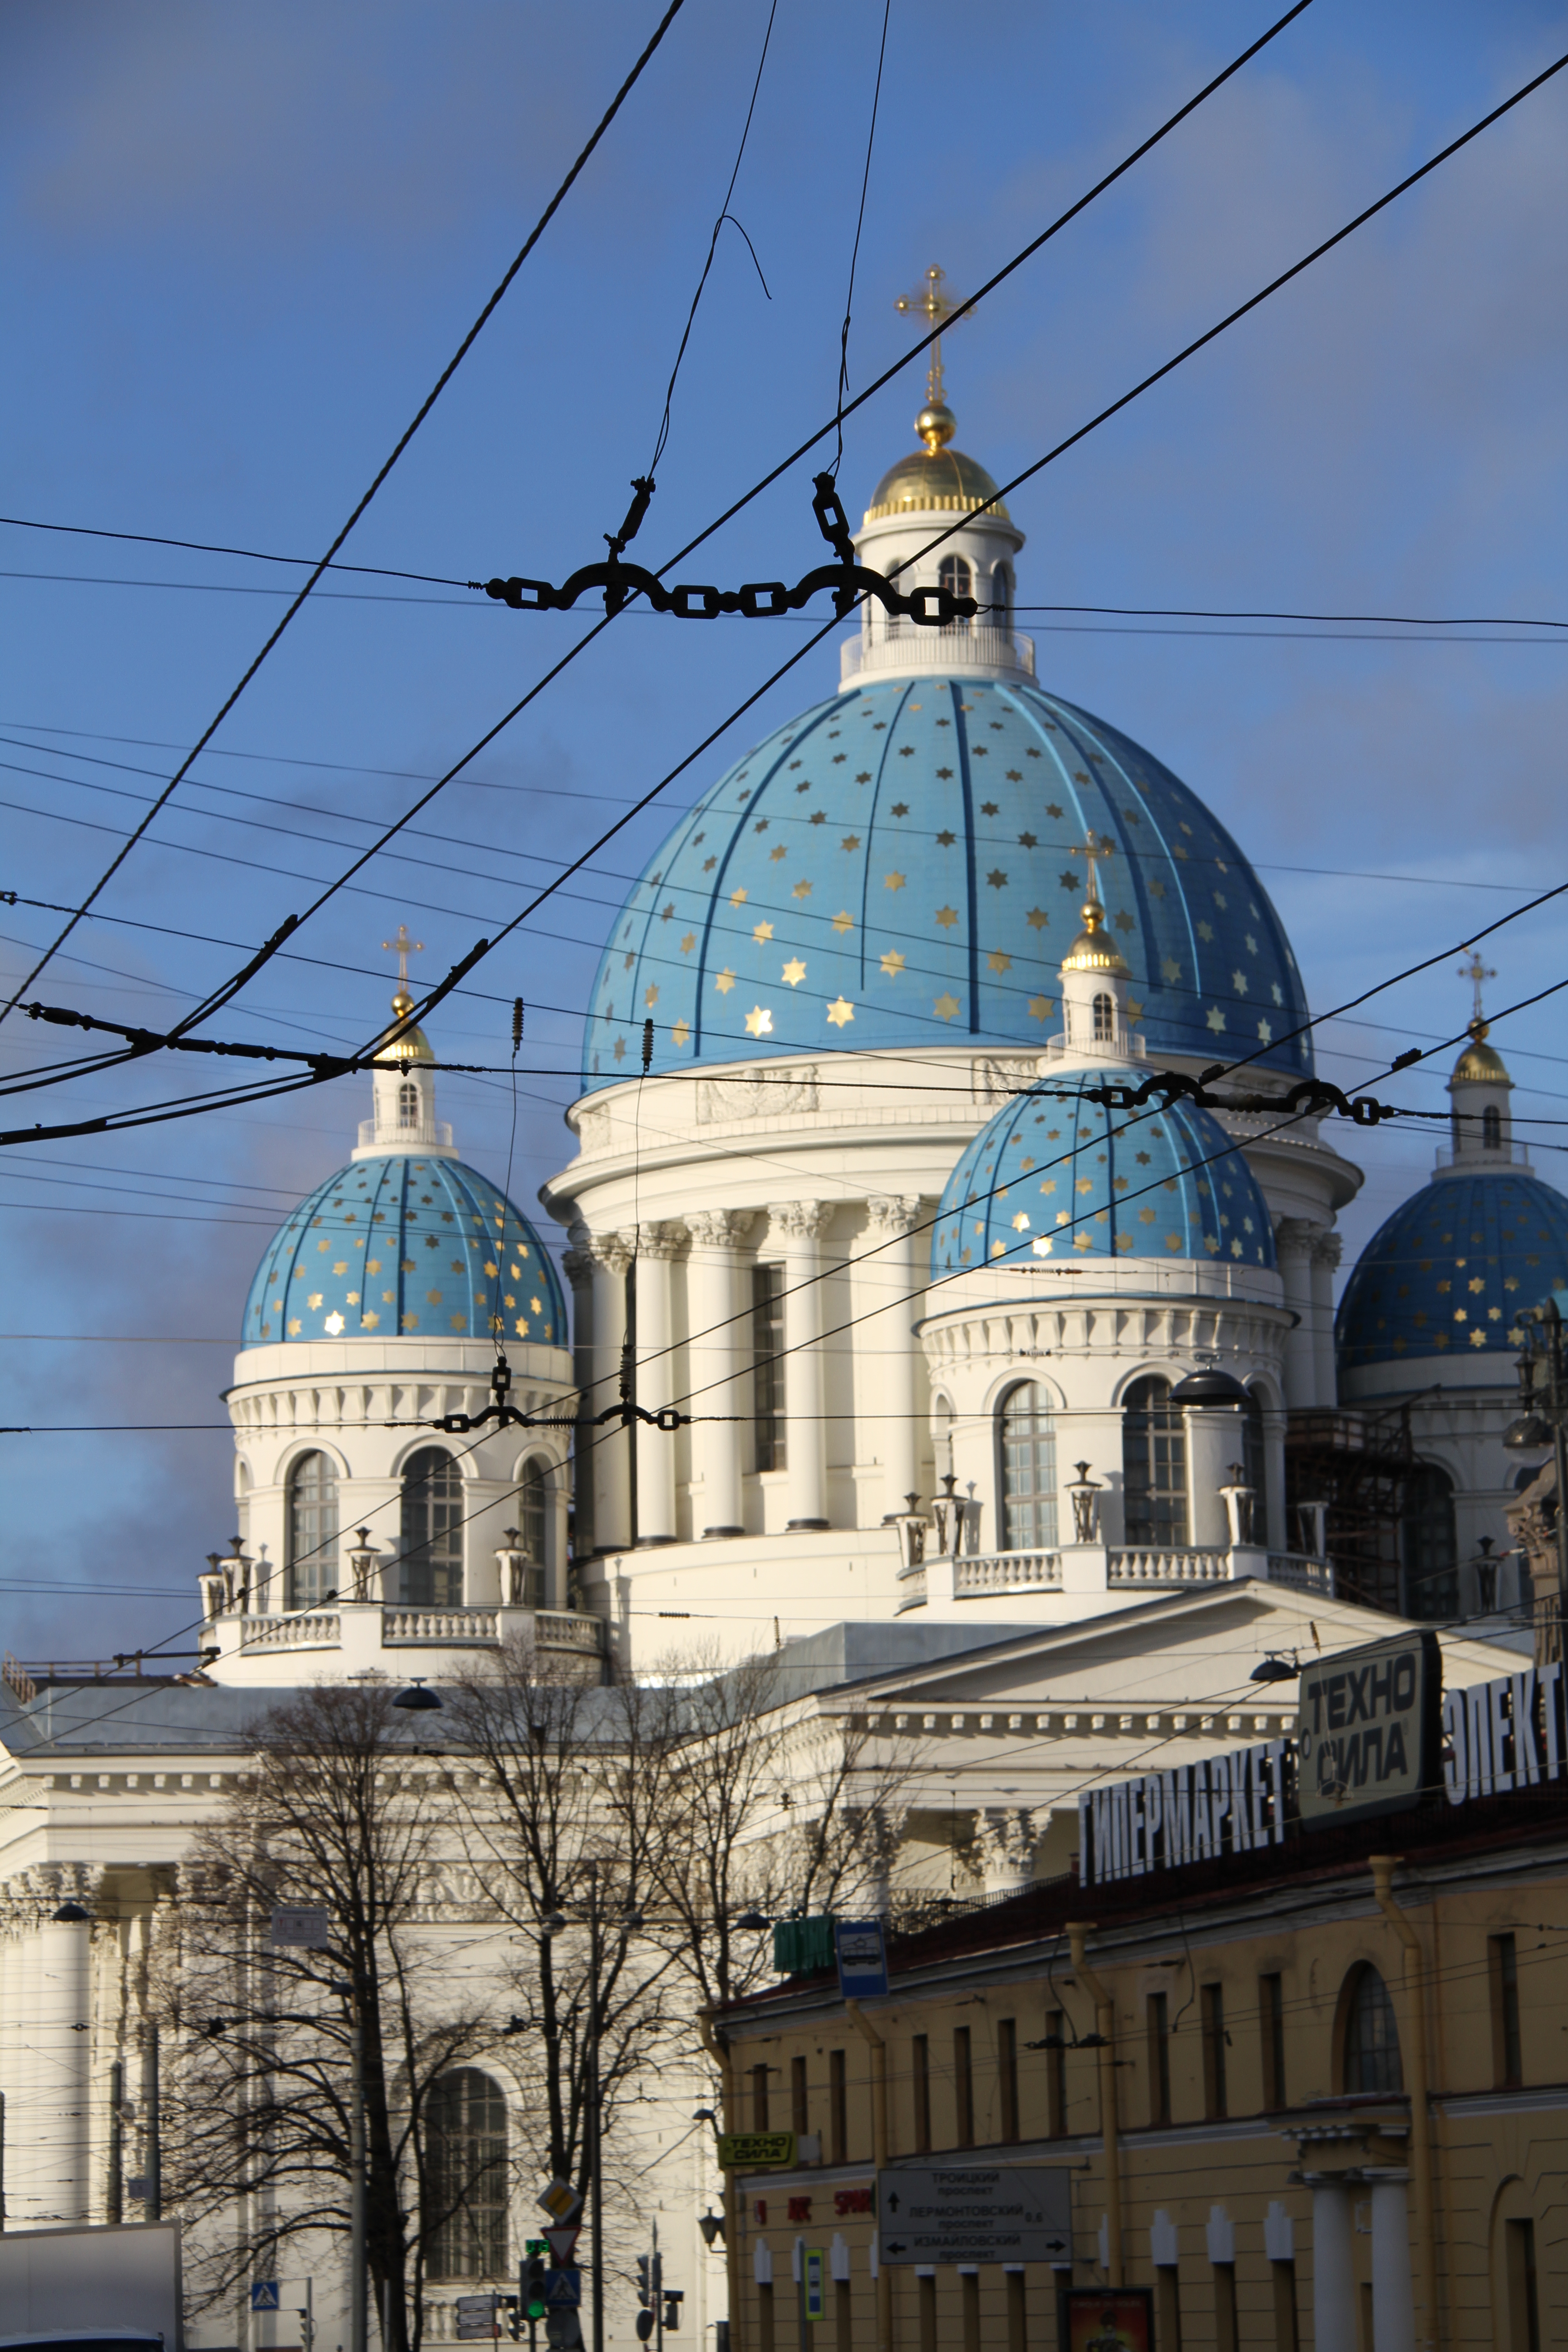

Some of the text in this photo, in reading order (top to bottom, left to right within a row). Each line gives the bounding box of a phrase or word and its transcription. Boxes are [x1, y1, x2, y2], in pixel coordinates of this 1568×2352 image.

[1308, 1653, 1416, 1734] ТЕХНО
[1317, 1721, 1407, 1796] СИЛА
[1078, 1738, 1286, 1888] ГИПЕРМАРКЕТ
[731, 2136, 786, 2148] ТЕХНО
[735, 2148, 781, 2159] СИЛА
[932, 2171, 1000, 2184] ТРОИЦКИЙ
[938, 2186, 993, 2197] проспект
[910, 2203, 1023, 2218] ЛЕРМОНТОВСКИЙ
[938, 2219, 994, 2230] проспект
[914, 2233, 1021, 2247] ИЗМАЙЛОВСКИЙ
[940, 2249, 995, 2260] проспект
